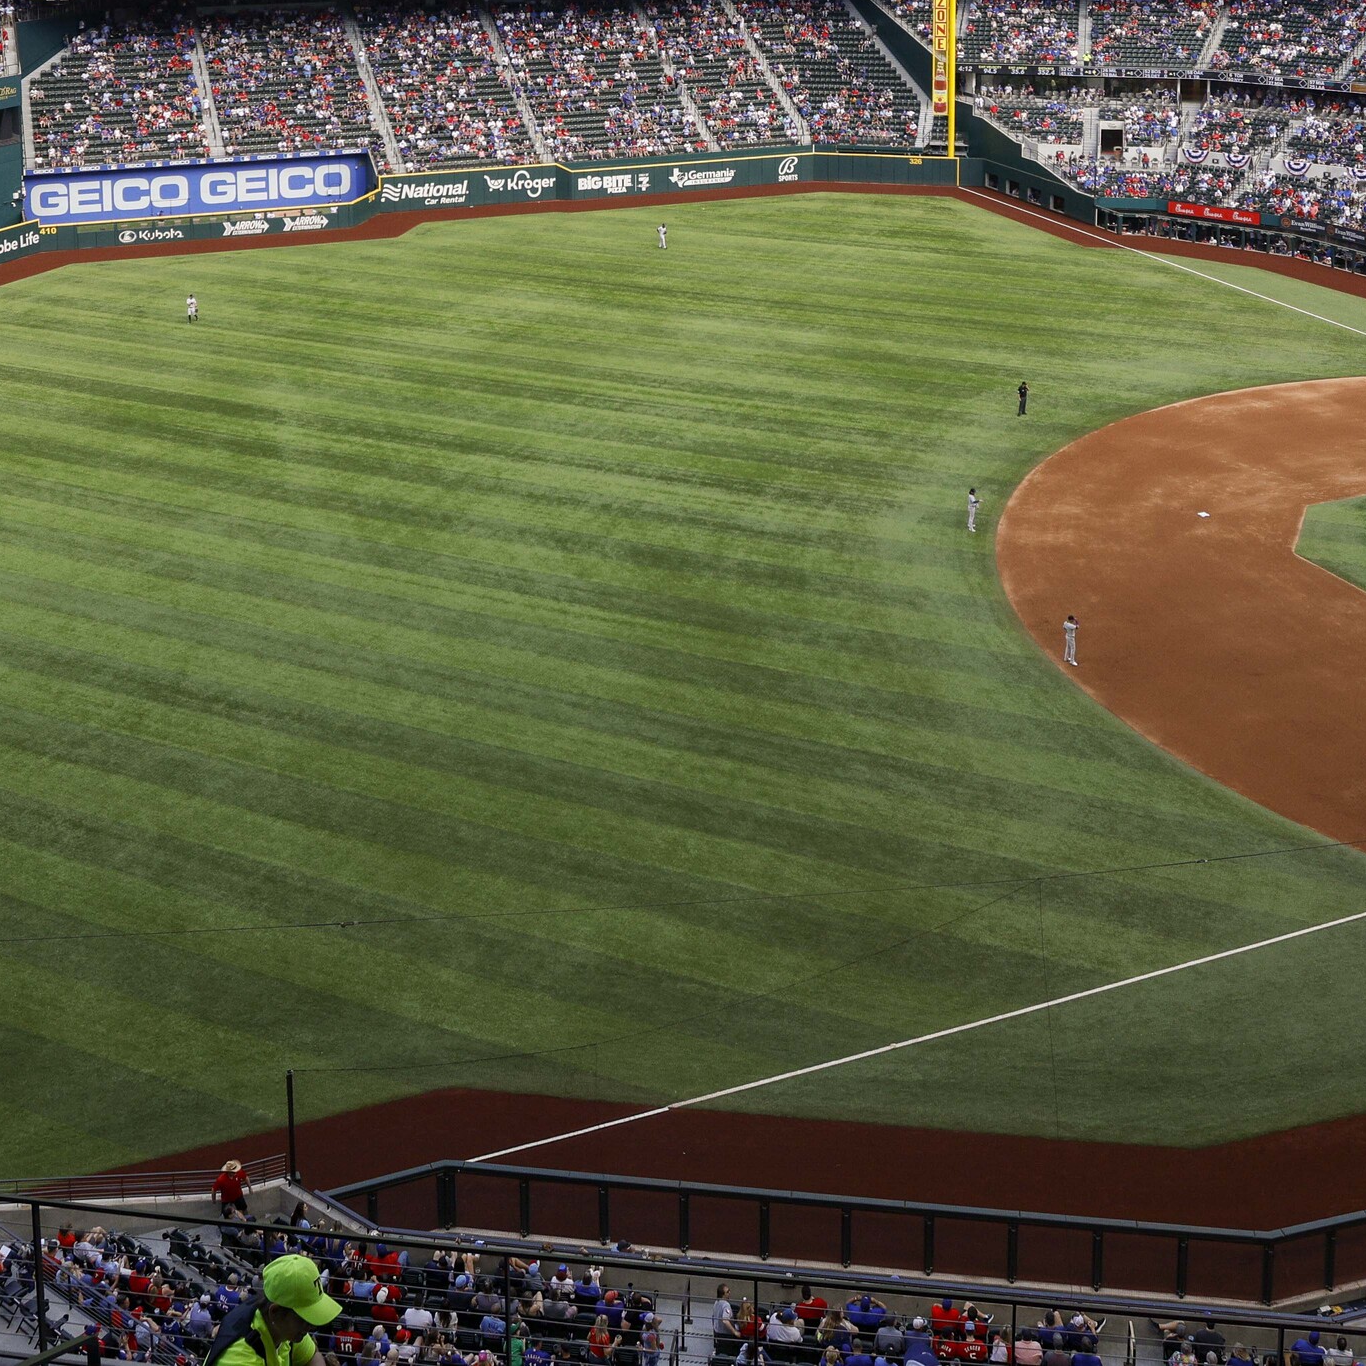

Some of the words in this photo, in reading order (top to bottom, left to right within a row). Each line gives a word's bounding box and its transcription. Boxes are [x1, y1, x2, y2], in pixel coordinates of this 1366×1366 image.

[689, 169, 736, 181] Germania
[778, 174, 798, 182] SPORTS
[507, 170, 556, 198] Kroger
[607, 184, 627, 194] PIZZA
[30, 175, 189, 218] GEICO
[199, 163, 351, 205] GEICO
[425, 197, 438, 205] Car
[440, 195, 465, 204] Rental
[234, 220, 264, 232] ARROW
[293, 215, 322, 228] ARROW
[39, 227, 57, 235] 410
[138, 229, 184, 241] Kubota
[20, 232, 40, 248] Life
